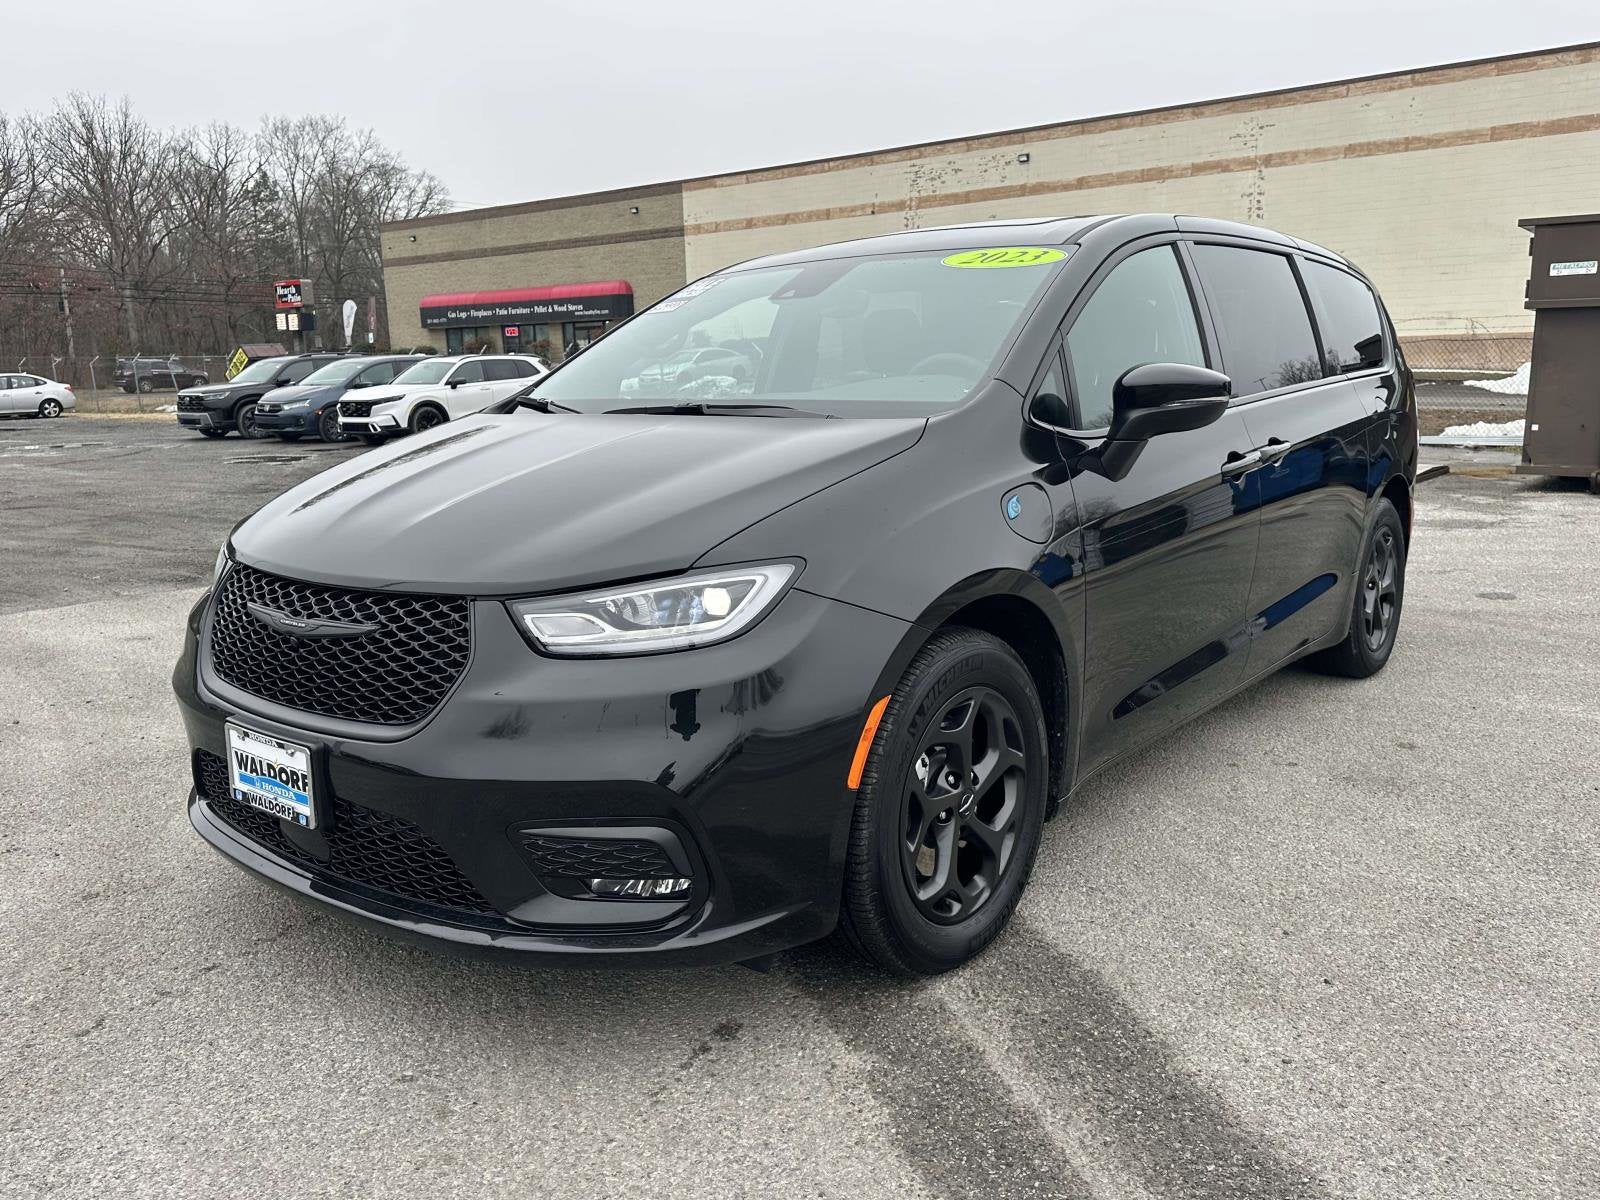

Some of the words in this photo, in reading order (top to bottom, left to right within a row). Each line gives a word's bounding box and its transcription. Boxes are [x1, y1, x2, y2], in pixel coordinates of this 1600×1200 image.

[957, 251, 1050, 264] 2023
[276, 285, 296, 295] Hearth
[456, 310, 467, 319] Logs
[470, 309, 493, 318] Fireplaces
[495, 307, 508, 315] Patio
[508, 306, 530, 315] Furniture
[534, 305, 548, 314] Pellet
[553, 304, 567, 312] Wood
[567, 303, 583, 312] Stoves
[234, 750, 309, 792] WALDORF
[262, 782, 297, 800] HONDA
[249, 792, 293, 819] WALDORF
